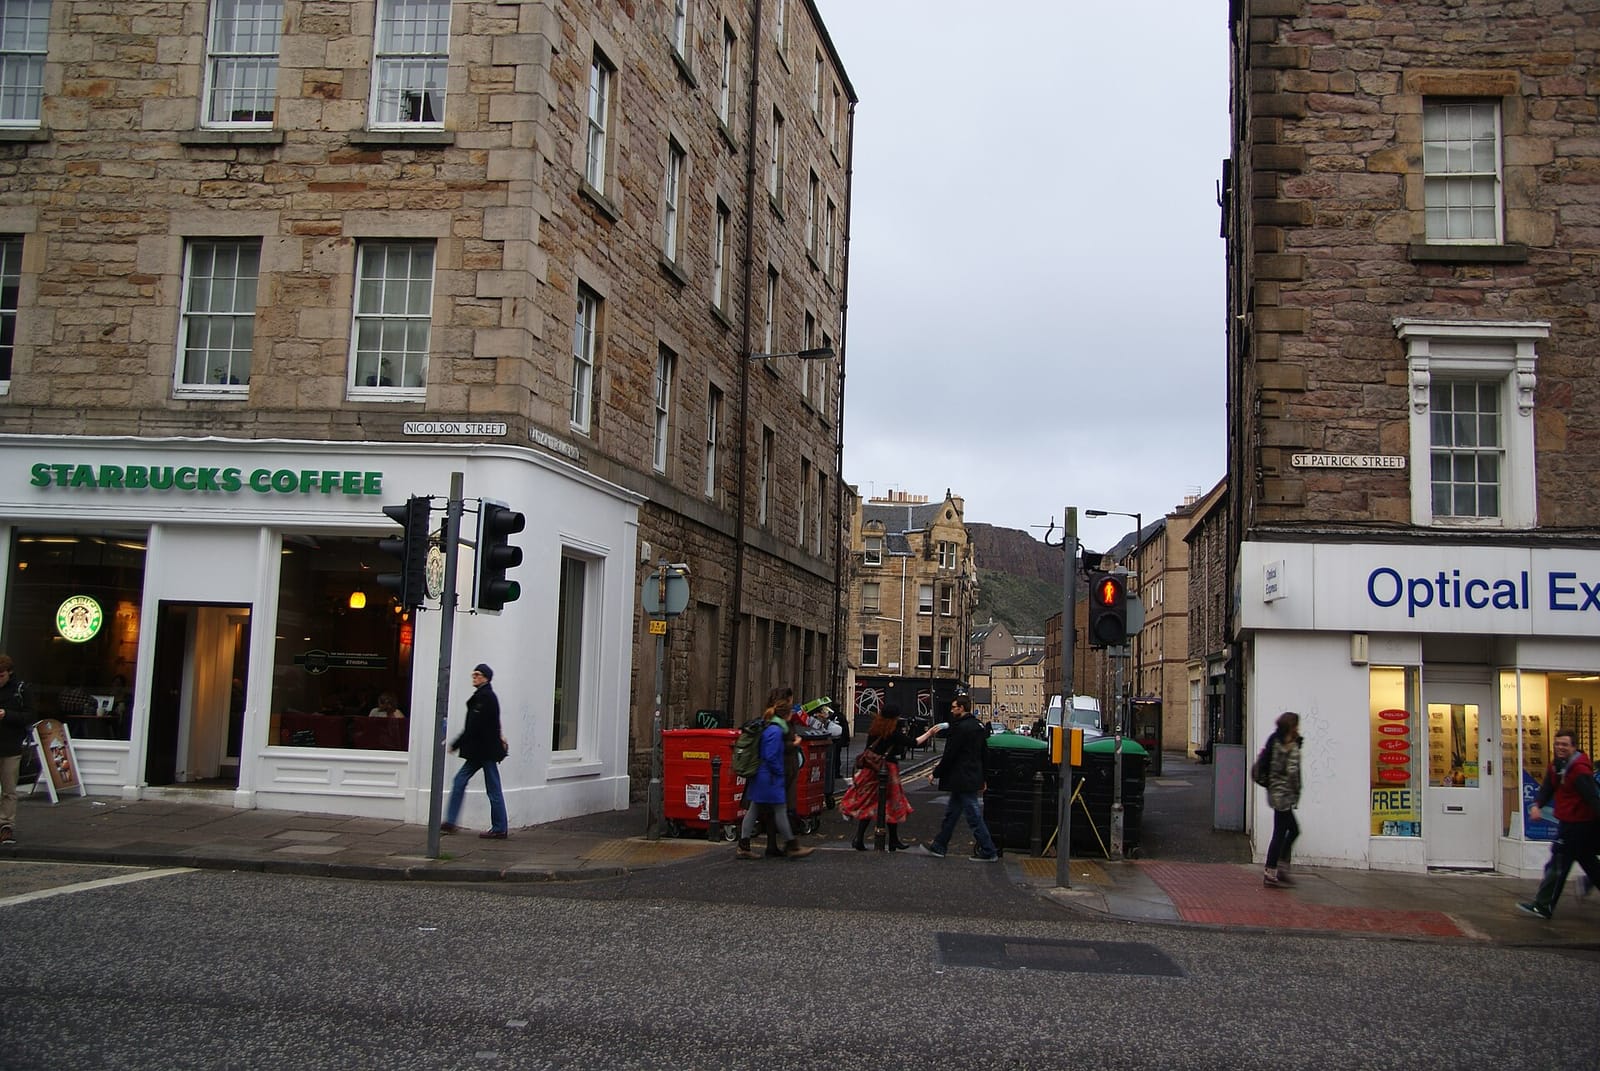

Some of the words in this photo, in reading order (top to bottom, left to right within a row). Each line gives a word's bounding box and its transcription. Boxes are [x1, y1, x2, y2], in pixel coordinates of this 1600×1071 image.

[406, 423, 461, 434] NICOLSON
[465, 424, 505, 434] STREET
[1311, 456, 1358, 466] PATRICK
[1362, 456, 1403, 467] STREET
[30, 463, 242, 492] STARBUCKS
[250, 469, 384, 495] COFFEE
[1367, 567, 1529, 618] Optical
[1548, 571, 1600, 611] Ex
[1372, 790, 1411, 810] FREE
